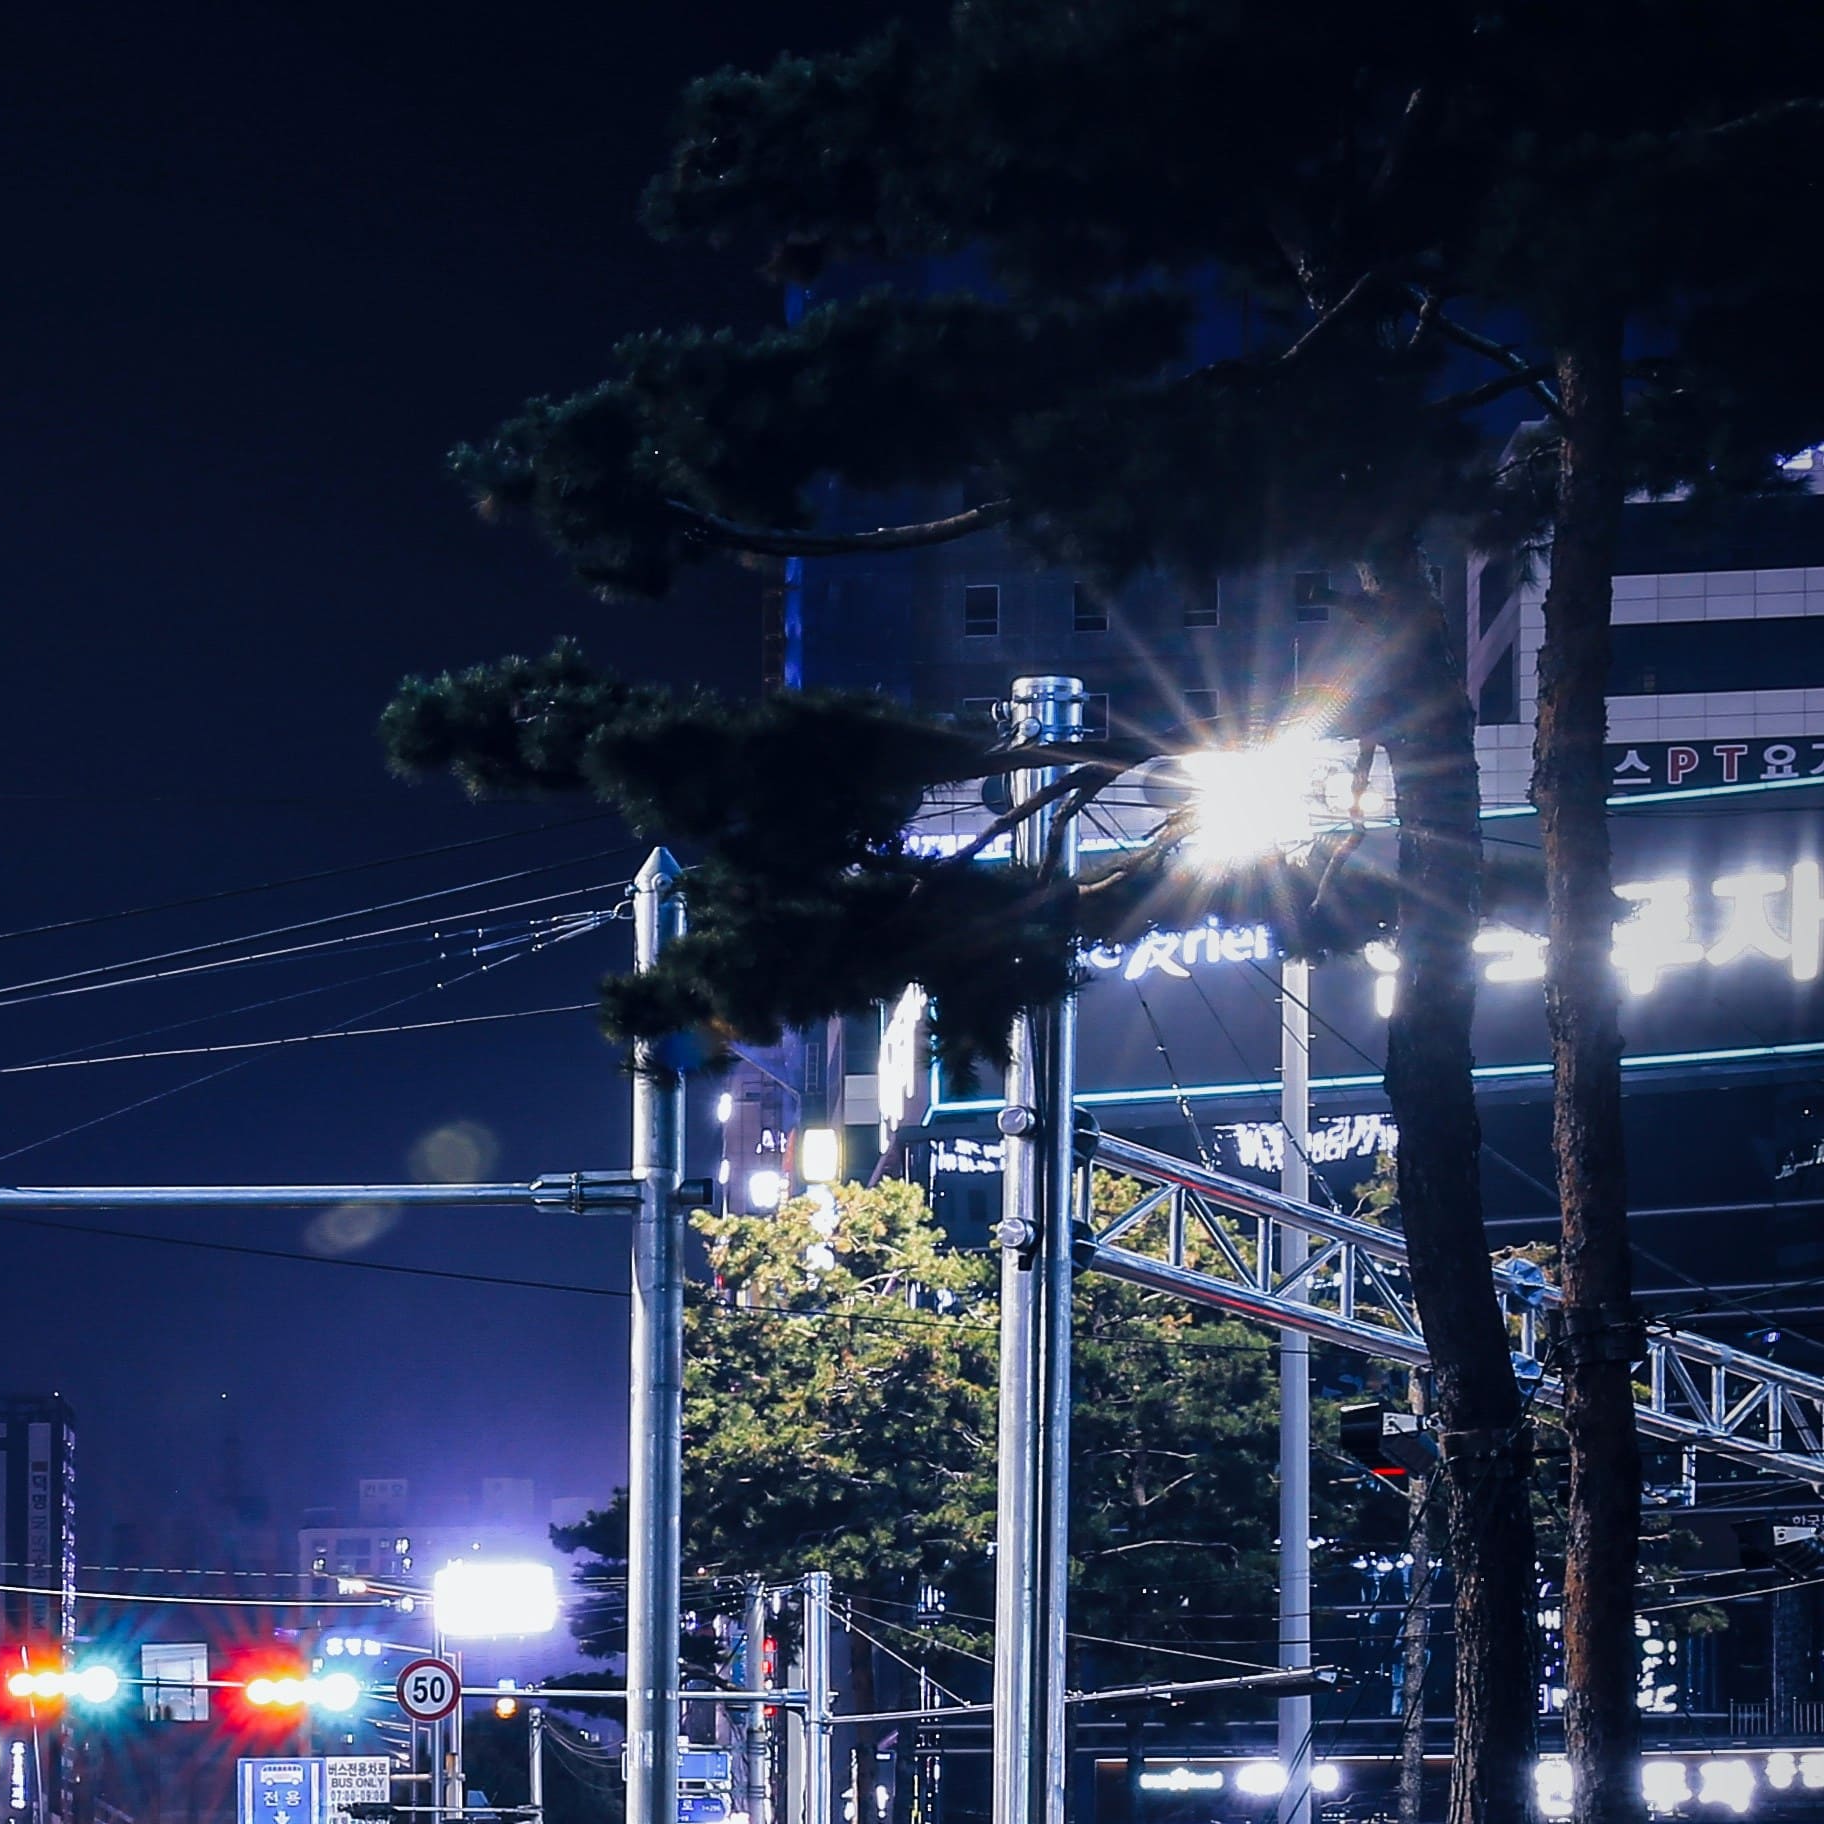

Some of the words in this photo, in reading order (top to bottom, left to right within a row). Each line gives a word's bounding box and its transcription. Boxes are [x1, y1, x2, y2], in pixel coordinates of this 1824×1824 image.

[412, 1675, 447, 1705] 50
[327, 1762, 388, 1777] 버스전용차로
[331, 1777, 354, 1788] BUS
[355, 1777, 385, 1788] ONLY
[263, 1790, 302, 1808] 전용
